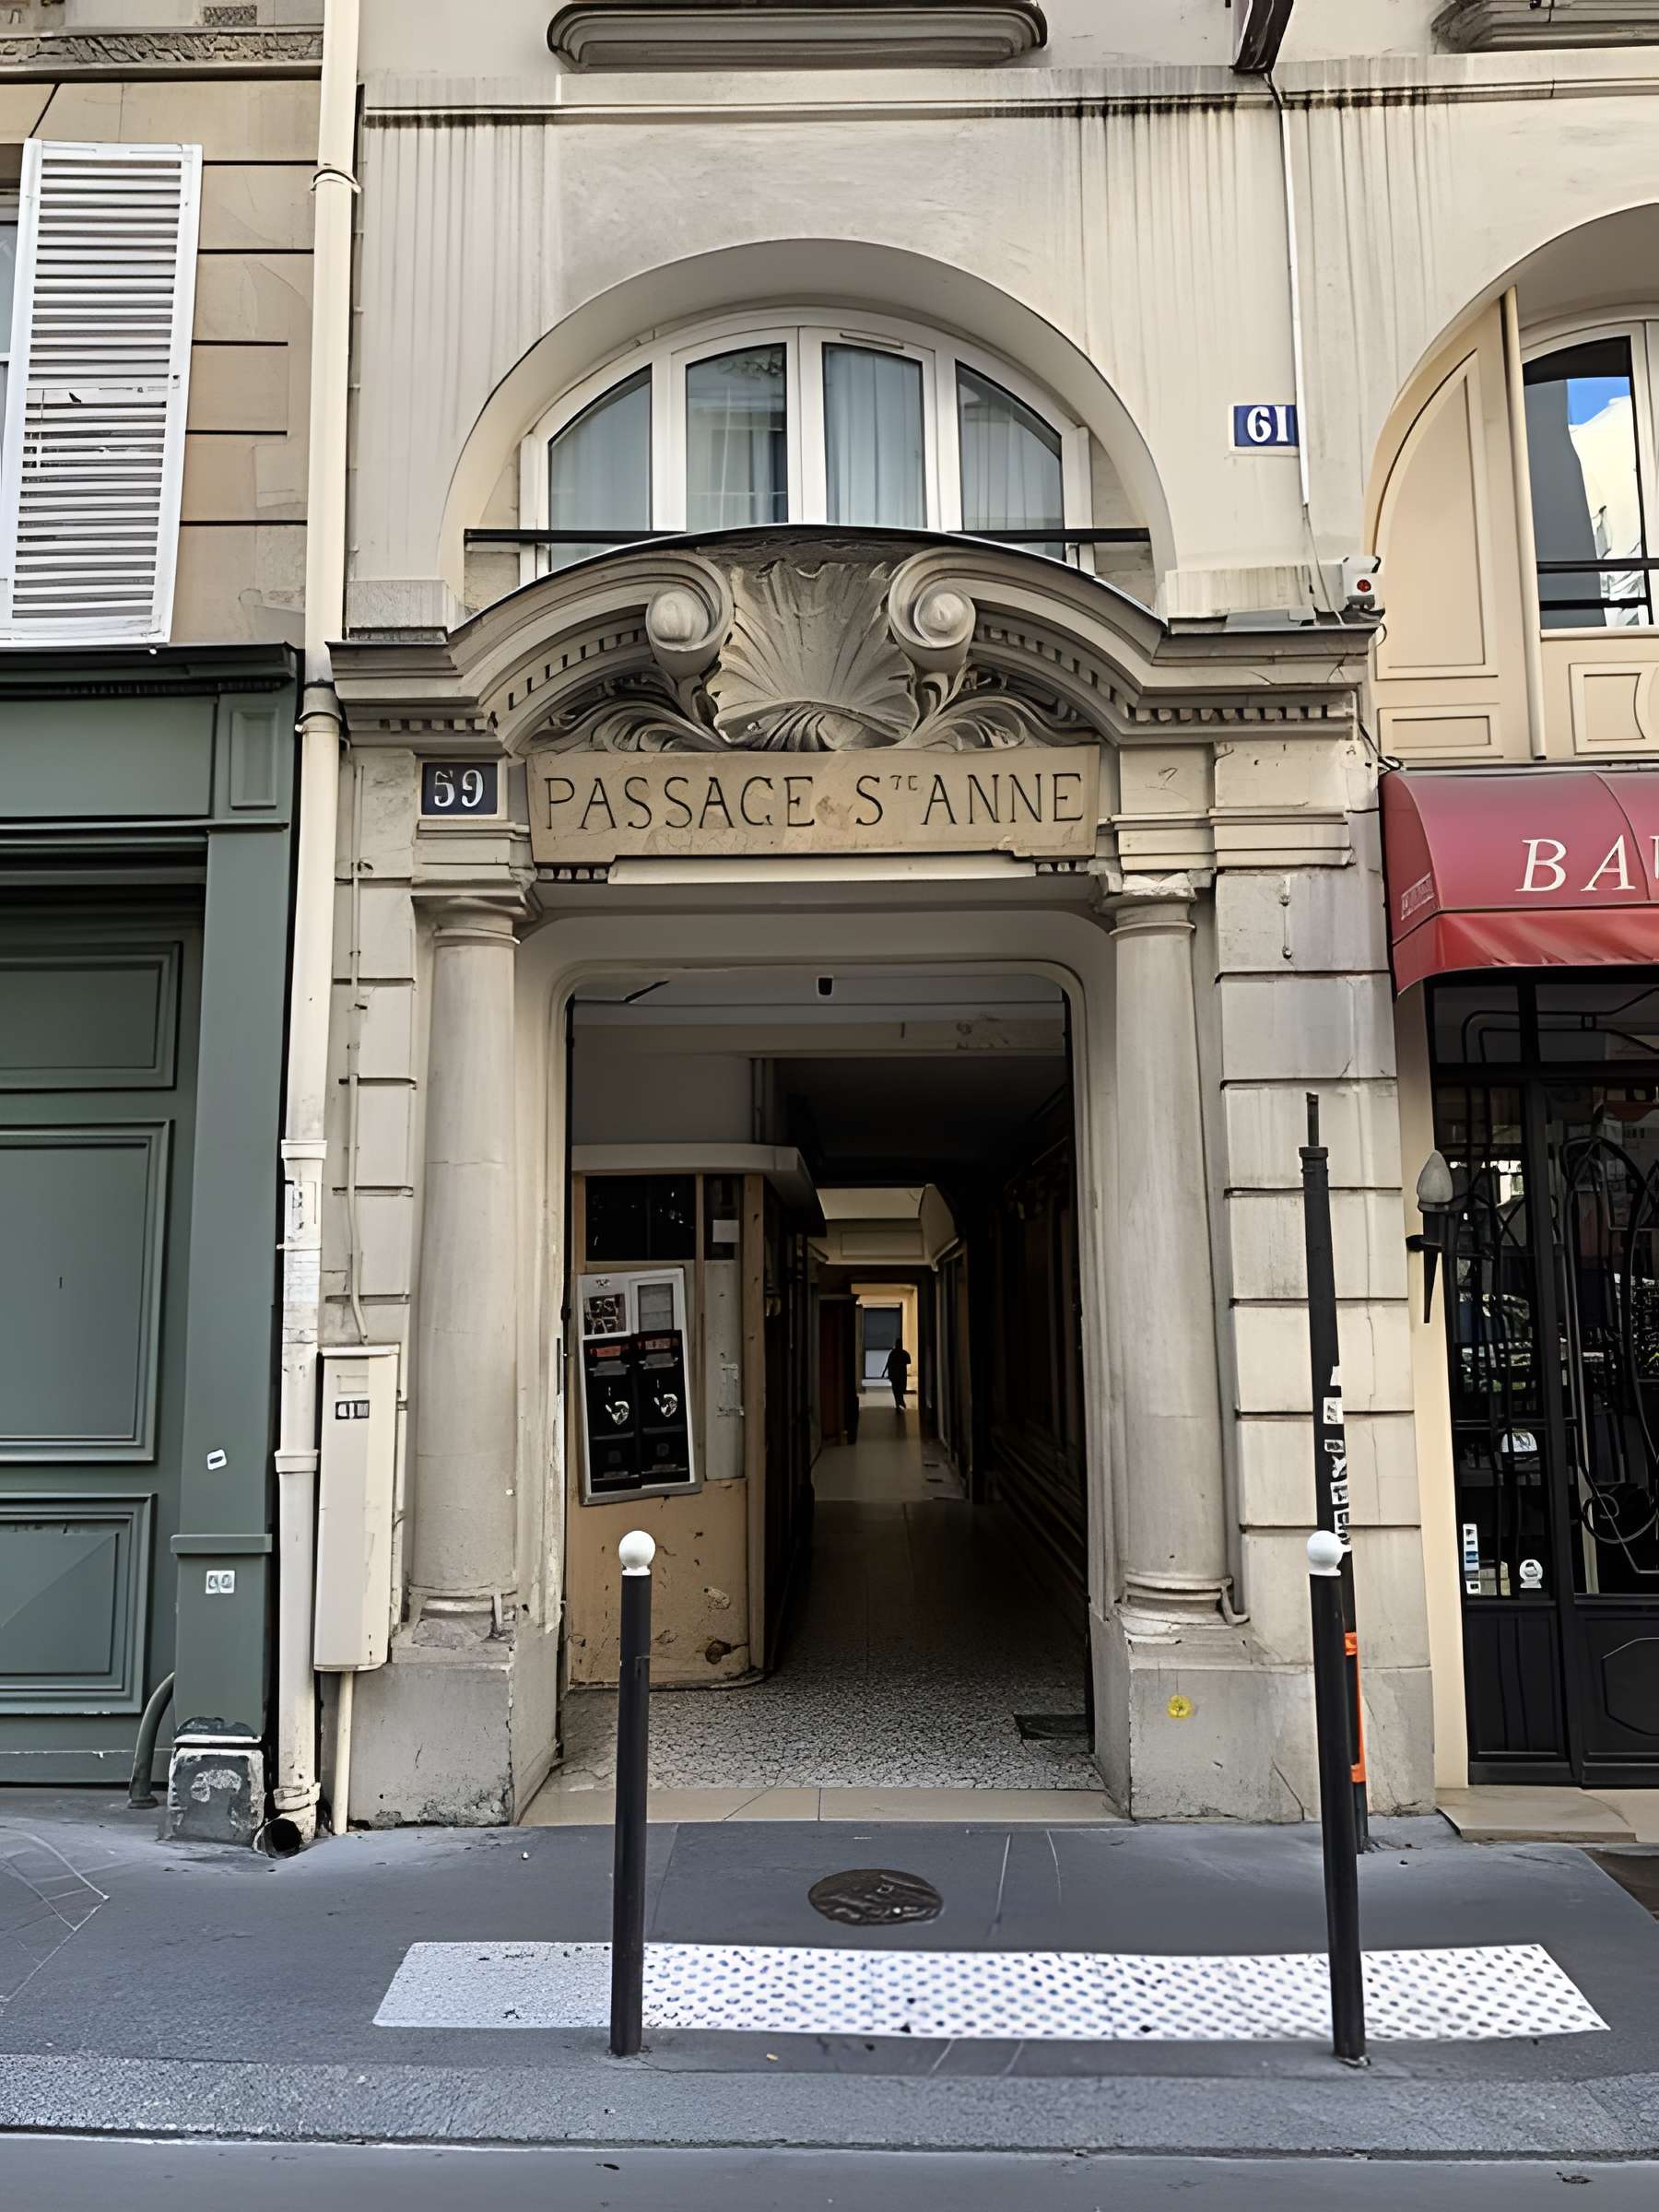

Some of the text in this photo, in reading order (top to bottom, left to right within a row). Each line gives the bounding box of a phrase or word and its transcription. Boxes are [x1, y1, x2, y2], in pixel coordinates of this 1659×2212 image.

[1246, 406, 1288, 443] 61
[433, 769, 484, 807] 59
[543, 775, 816, 830] PASSAGE
[920, 772, 1084, 826] ANNE
